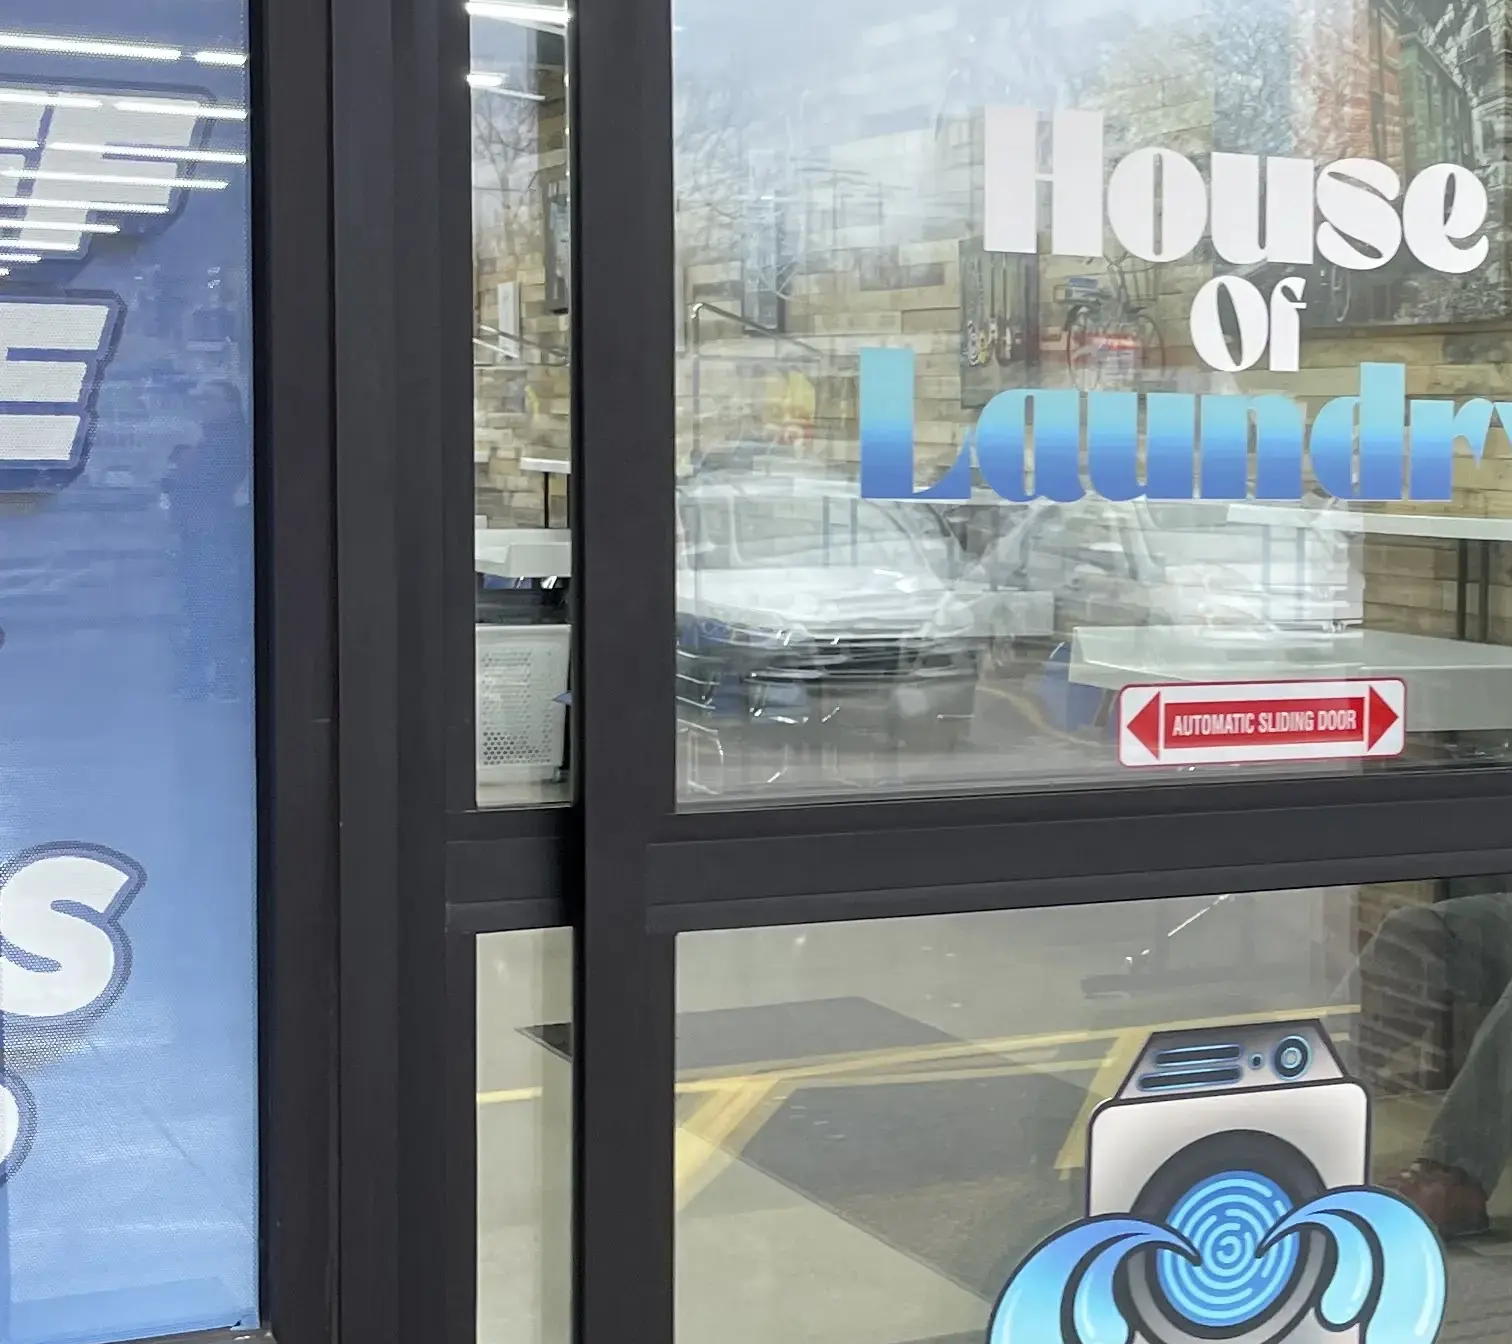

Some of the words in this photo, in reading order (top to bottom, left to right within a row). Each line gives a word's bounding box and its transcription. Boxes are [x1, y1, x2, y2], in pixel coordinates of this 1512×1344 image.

[984, 107, 1488, 274] House
[1190, 275, 1307, 372] Of
[1172, 713, 1255, 736] AUTOMATIC
[1258, 710, 1314, 733] SLIDING
[1317, 709, 1357, 731] DOOR
